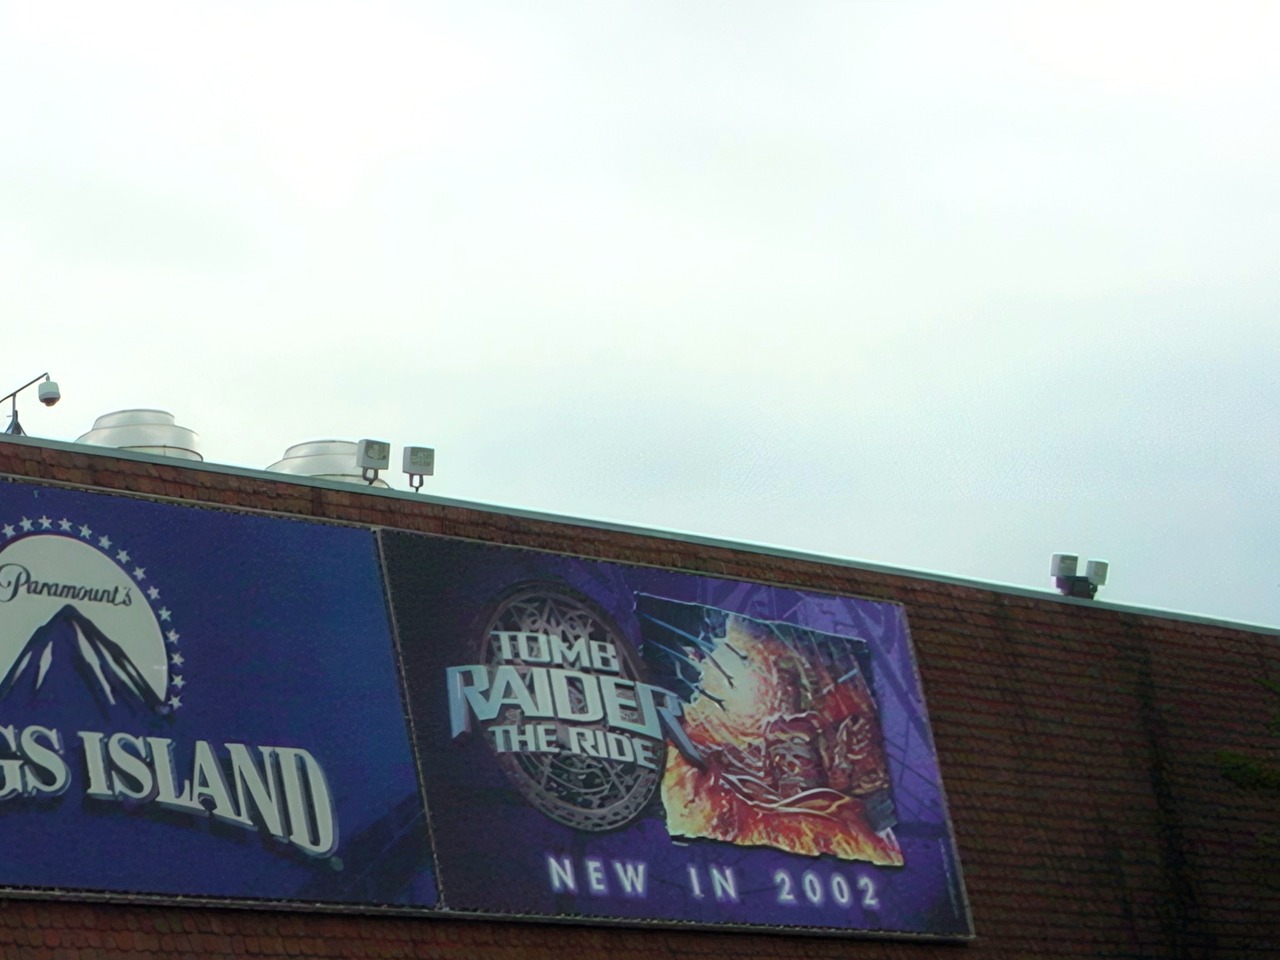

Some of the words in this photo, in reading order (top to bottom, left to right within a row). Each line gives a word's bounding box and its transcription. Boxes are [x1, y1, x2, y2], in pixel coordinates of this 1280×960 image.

[490, 631, 620, 672] TOMB
[446, 664, 708, 772] RAIDER
[488, 723, 560, 754] THE
[568, 725, 659, 771] RIDE
[76, 730, 341, 860] ISLAND
[547, 856, 647, 898] NEW
[687, 867, 739, 901] IN
[774, 869, 881, 908] 2002
